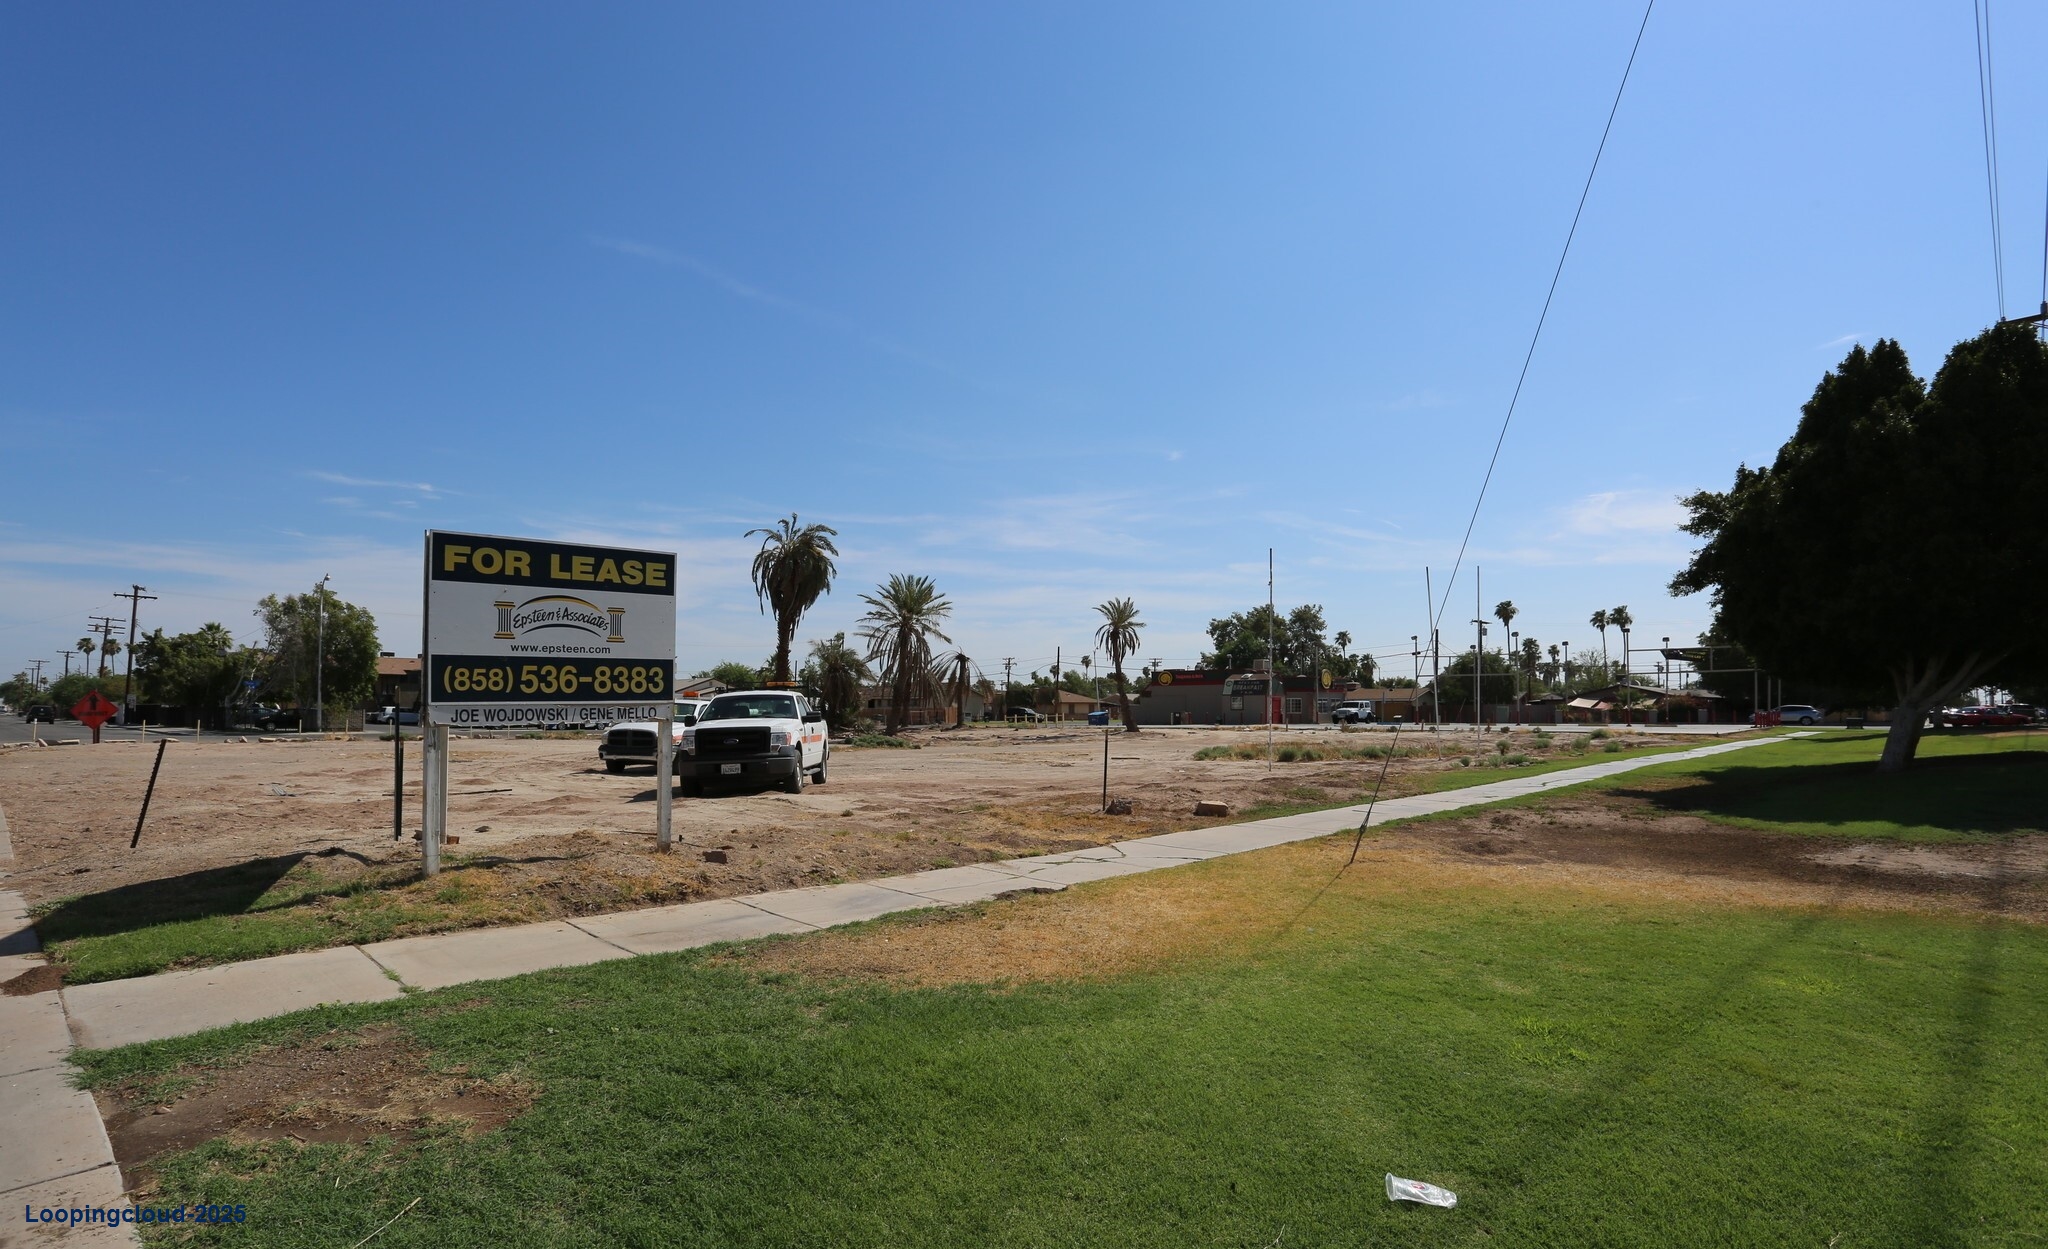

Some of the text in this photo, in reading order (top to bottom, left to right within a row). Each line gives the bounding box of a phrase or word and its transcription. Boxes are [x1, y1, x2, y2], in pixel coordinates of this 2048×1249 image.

[443, 544, 667, 587] FOR LEASE
[513, 608, 555, 630] Epsteen
[561, 607, 610, 631] Associates
[510, 643, 611, 655] www.epsteen.com
[443, 664, 665, 695] (858) 536-8383
[450, 708, 479, 723] JOE
[484, 707, 568, 722] WOJDOWSKI
[579, 707, 613, 720] GENE
[617, 706, 657, 720] MELLO
